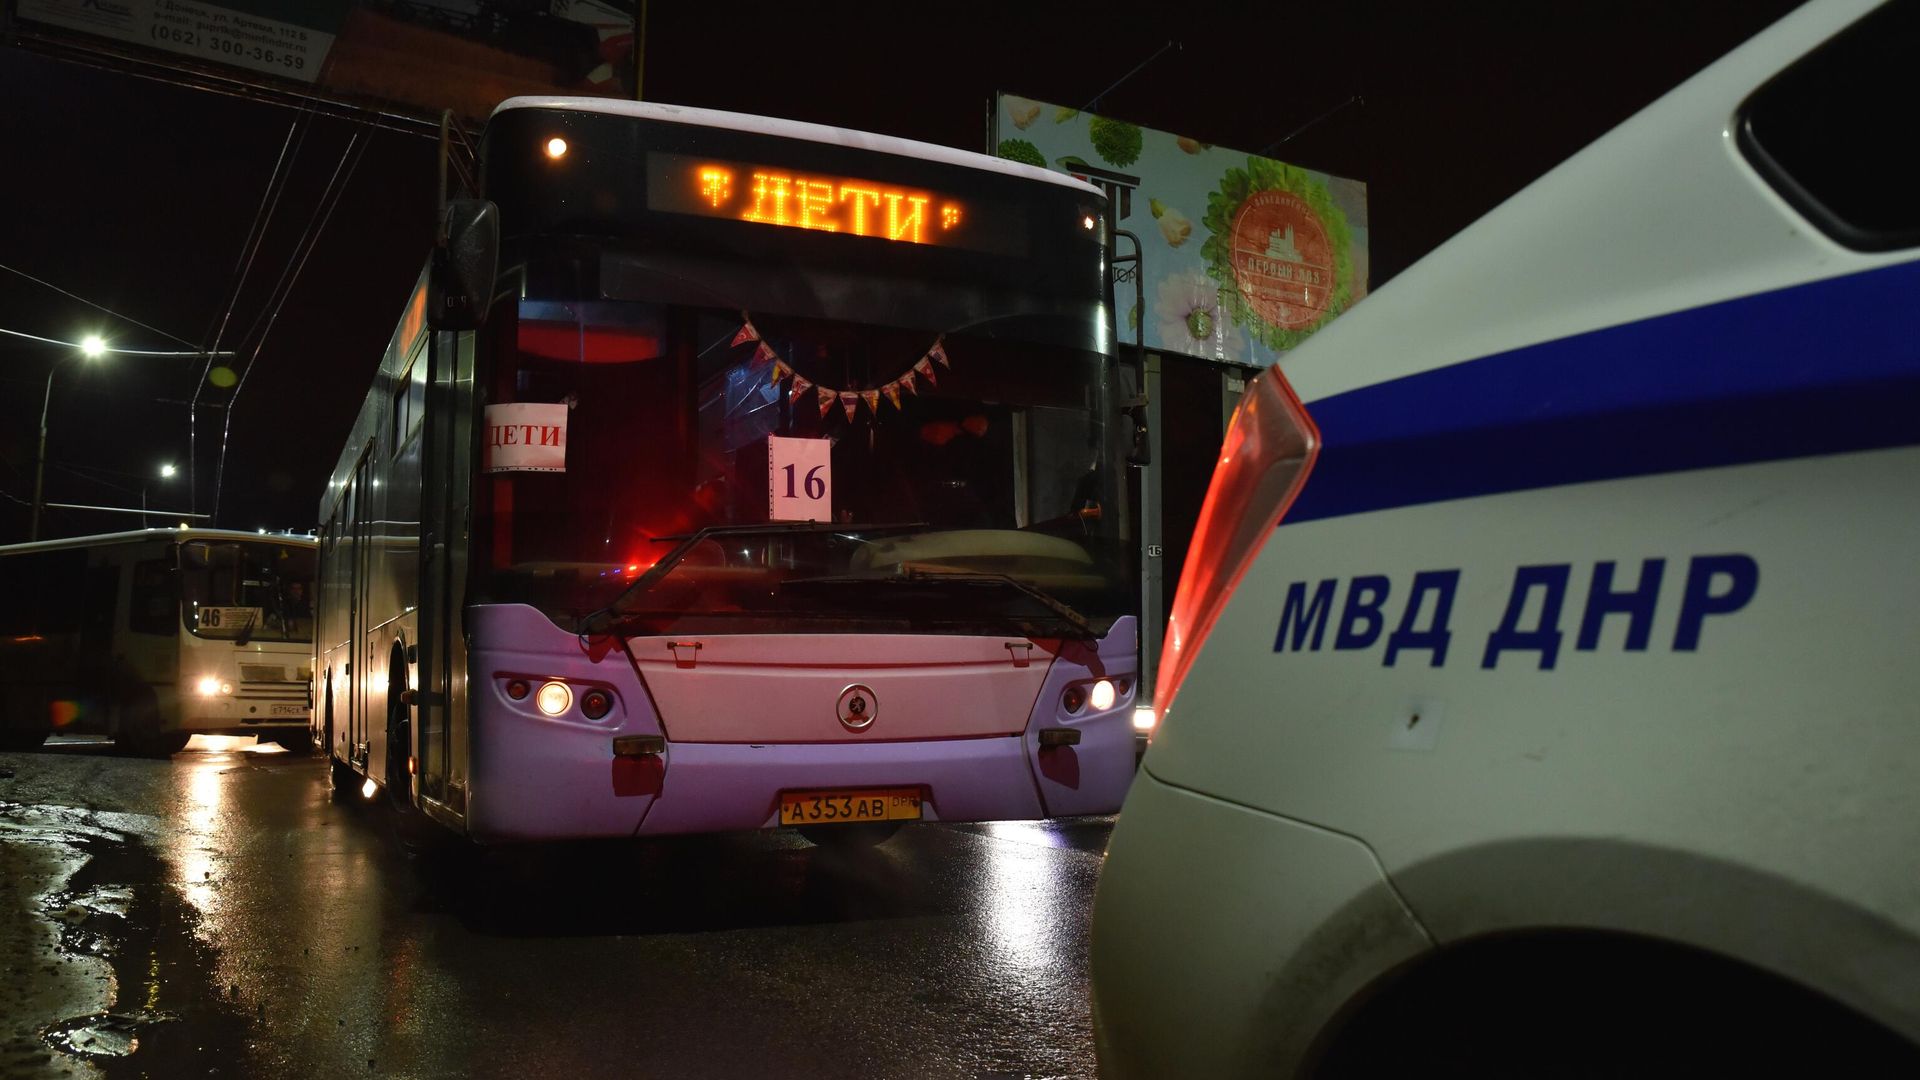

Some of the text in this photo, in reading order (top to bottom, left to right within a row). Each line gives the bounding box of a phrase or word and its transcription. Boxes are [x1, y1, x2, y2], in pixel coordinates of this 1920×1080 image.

[151, 24, 305, 70] (062) 300-36-59
[743, 173, 930, 244] ДЕТИ
[489, 424, 561, 449] ДЕТИ
[782, 464, 827, 500] 16
[201, 608, 221, 627] 46
[1273, 553, 1760, 670] МВД ДНР
